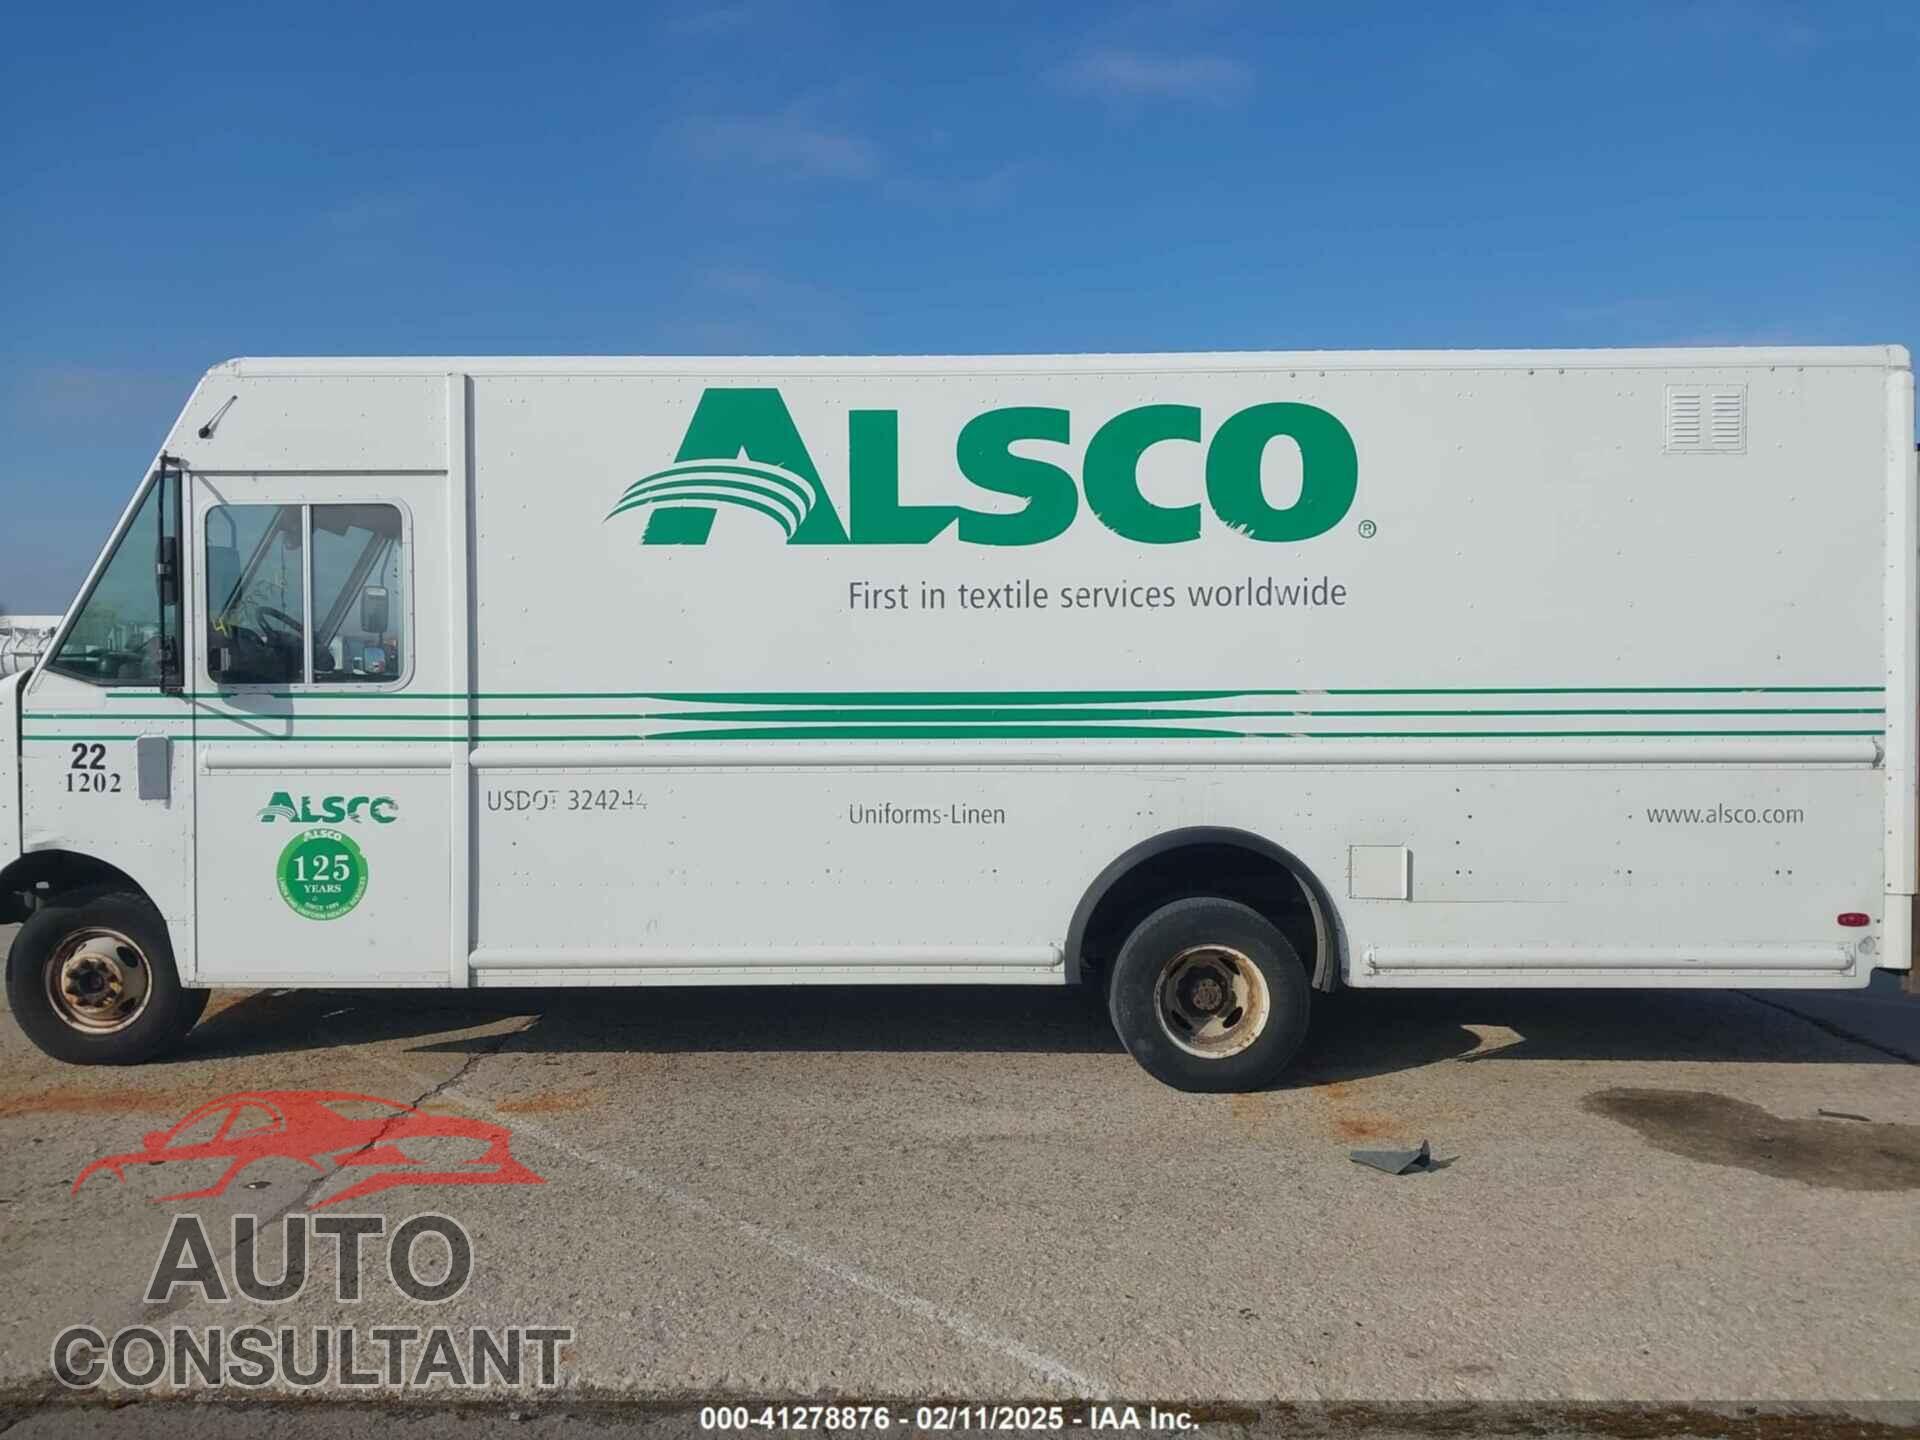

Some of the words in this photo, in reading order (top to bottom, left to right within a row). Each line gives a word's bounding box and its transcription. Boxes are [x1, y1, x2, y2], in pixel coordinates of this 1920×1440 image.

[606, 387, 1359, 546] ALSCO
[849, 582, 909, 609] First
[921, 581, 945, 609] in
[957, 579, 1048, 609] textile
[1060, 579, 1176, 608] services
[1188, 576, 1347, 607] worldwide
[71, 742, 106, 770] 22
[65, 773, 121, 792] 1202
[487, 790, 560, 811] USDOT
[1647, 803, 1804, 824] www.alsco.com
[303, 830, 342, 842] ALSCO
[293, 854, 351, 882] 125
[303, 884, 342, 893] YEARS
